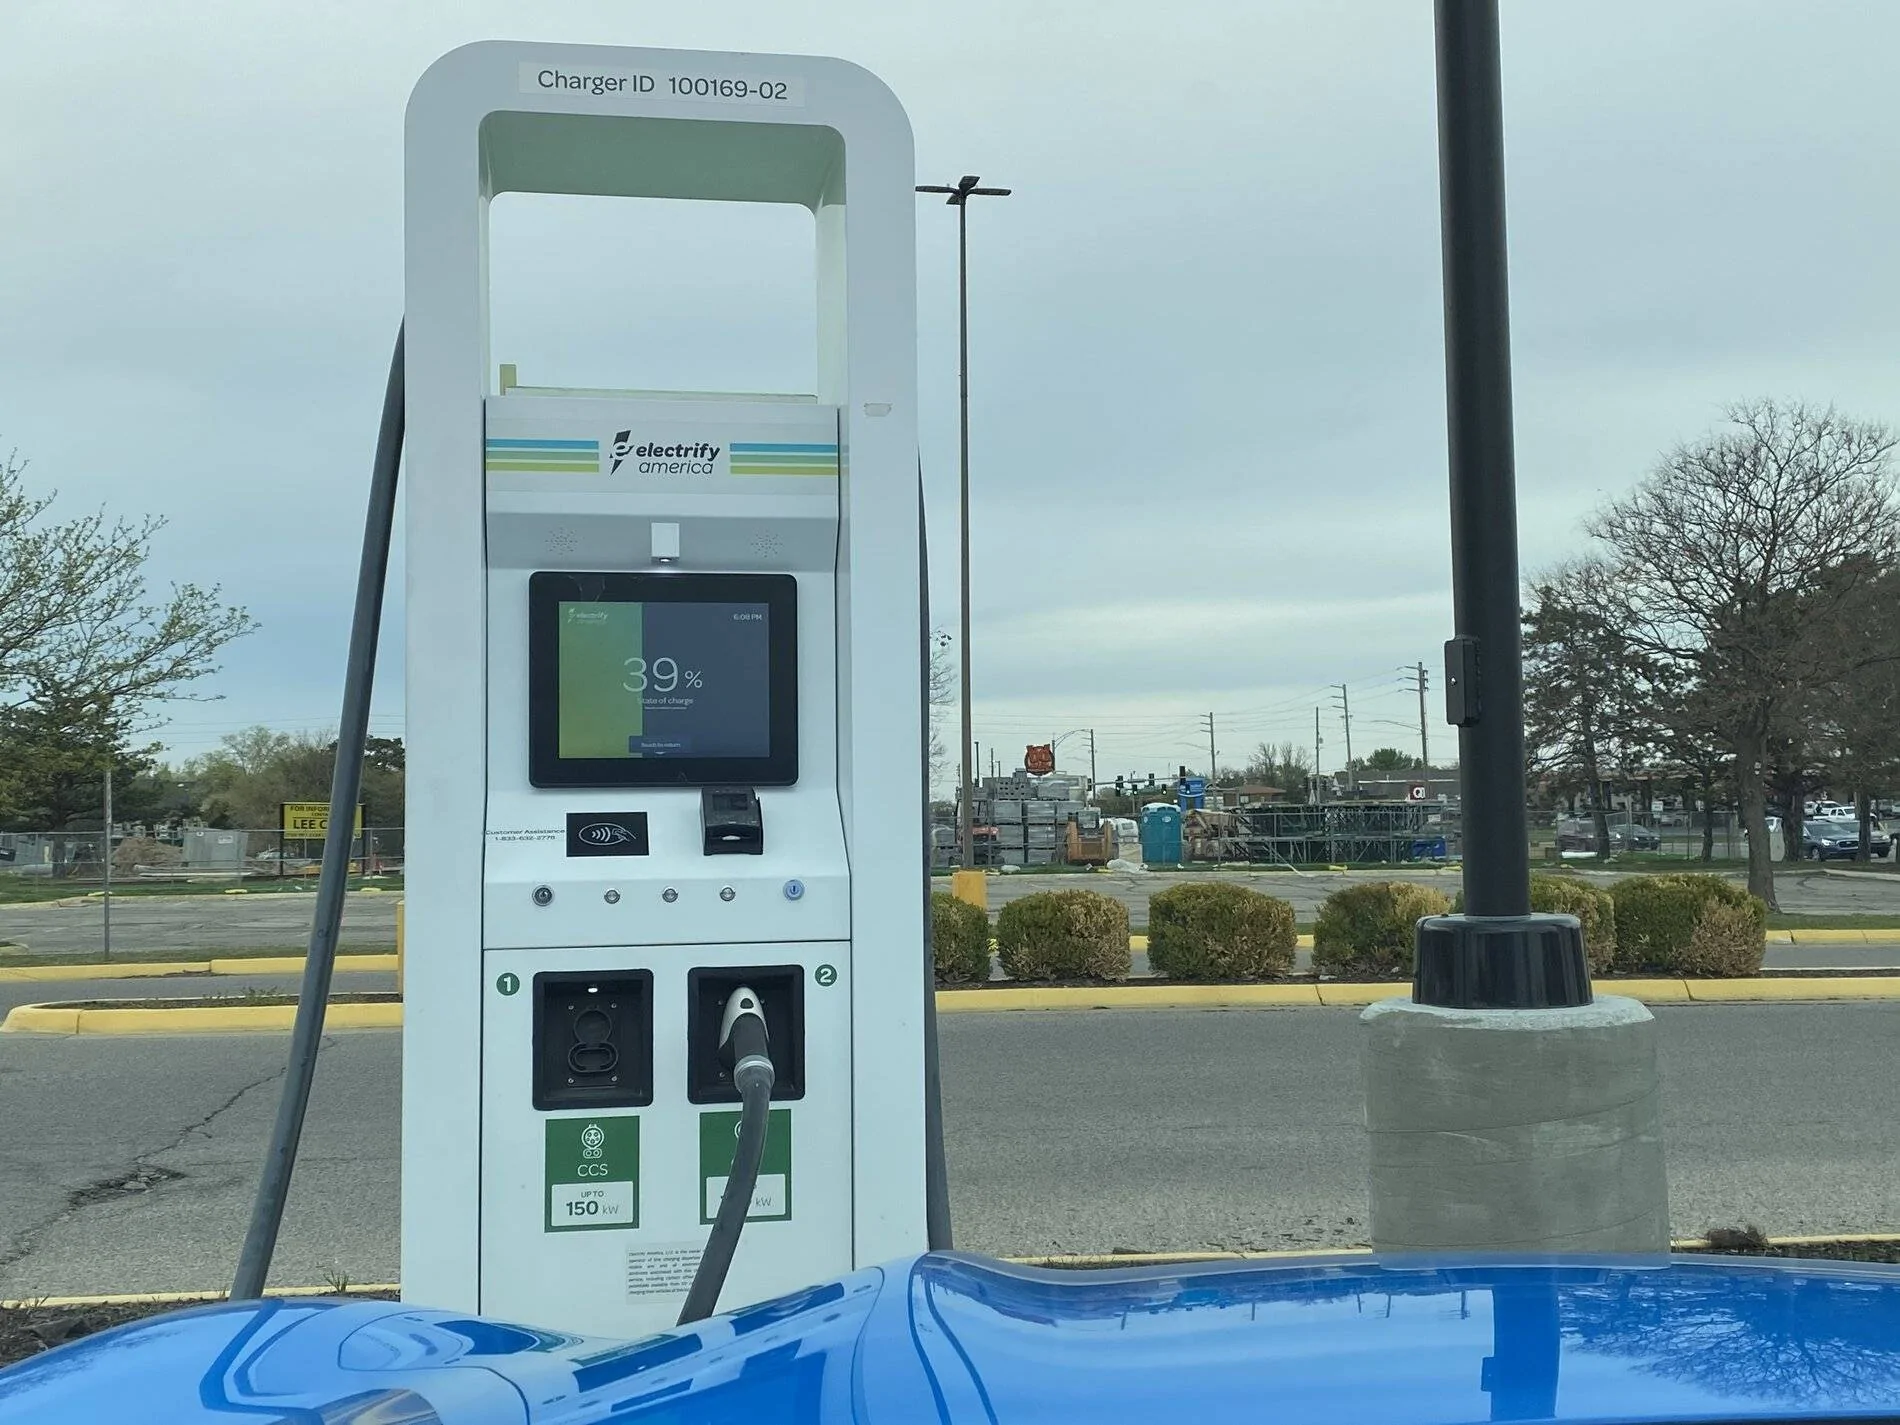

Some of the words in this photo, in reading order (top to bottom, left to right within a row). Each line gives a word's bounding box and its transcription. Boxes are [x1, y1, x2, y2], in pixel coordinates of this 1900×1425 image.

[537, 70, 627, 96] Charger
[632, 75, 655, 93] ID
[668, 76, 788, 100] 100169-02
[636, 442, 720, 462] electrify
[638, 460, 714, 475] america
[751, 613, 762, 621] PM
[658, 696, 667, 705] of
[667, 696, 694, 706] charge
[293, 819, 317, 830] LEE
[818, 968, 833, 983] 2
[503, 976, 513, 992] 1
[577, 1163, 609, 1177] CCS
[580, 1190, 593, 1198] UP
[593, 1190, 604, 1198] TO
[565, 1200, 599, 1216] 150
[602, 1204, 619, 1215] kW
[755, 1197, 772, 1208] kW
